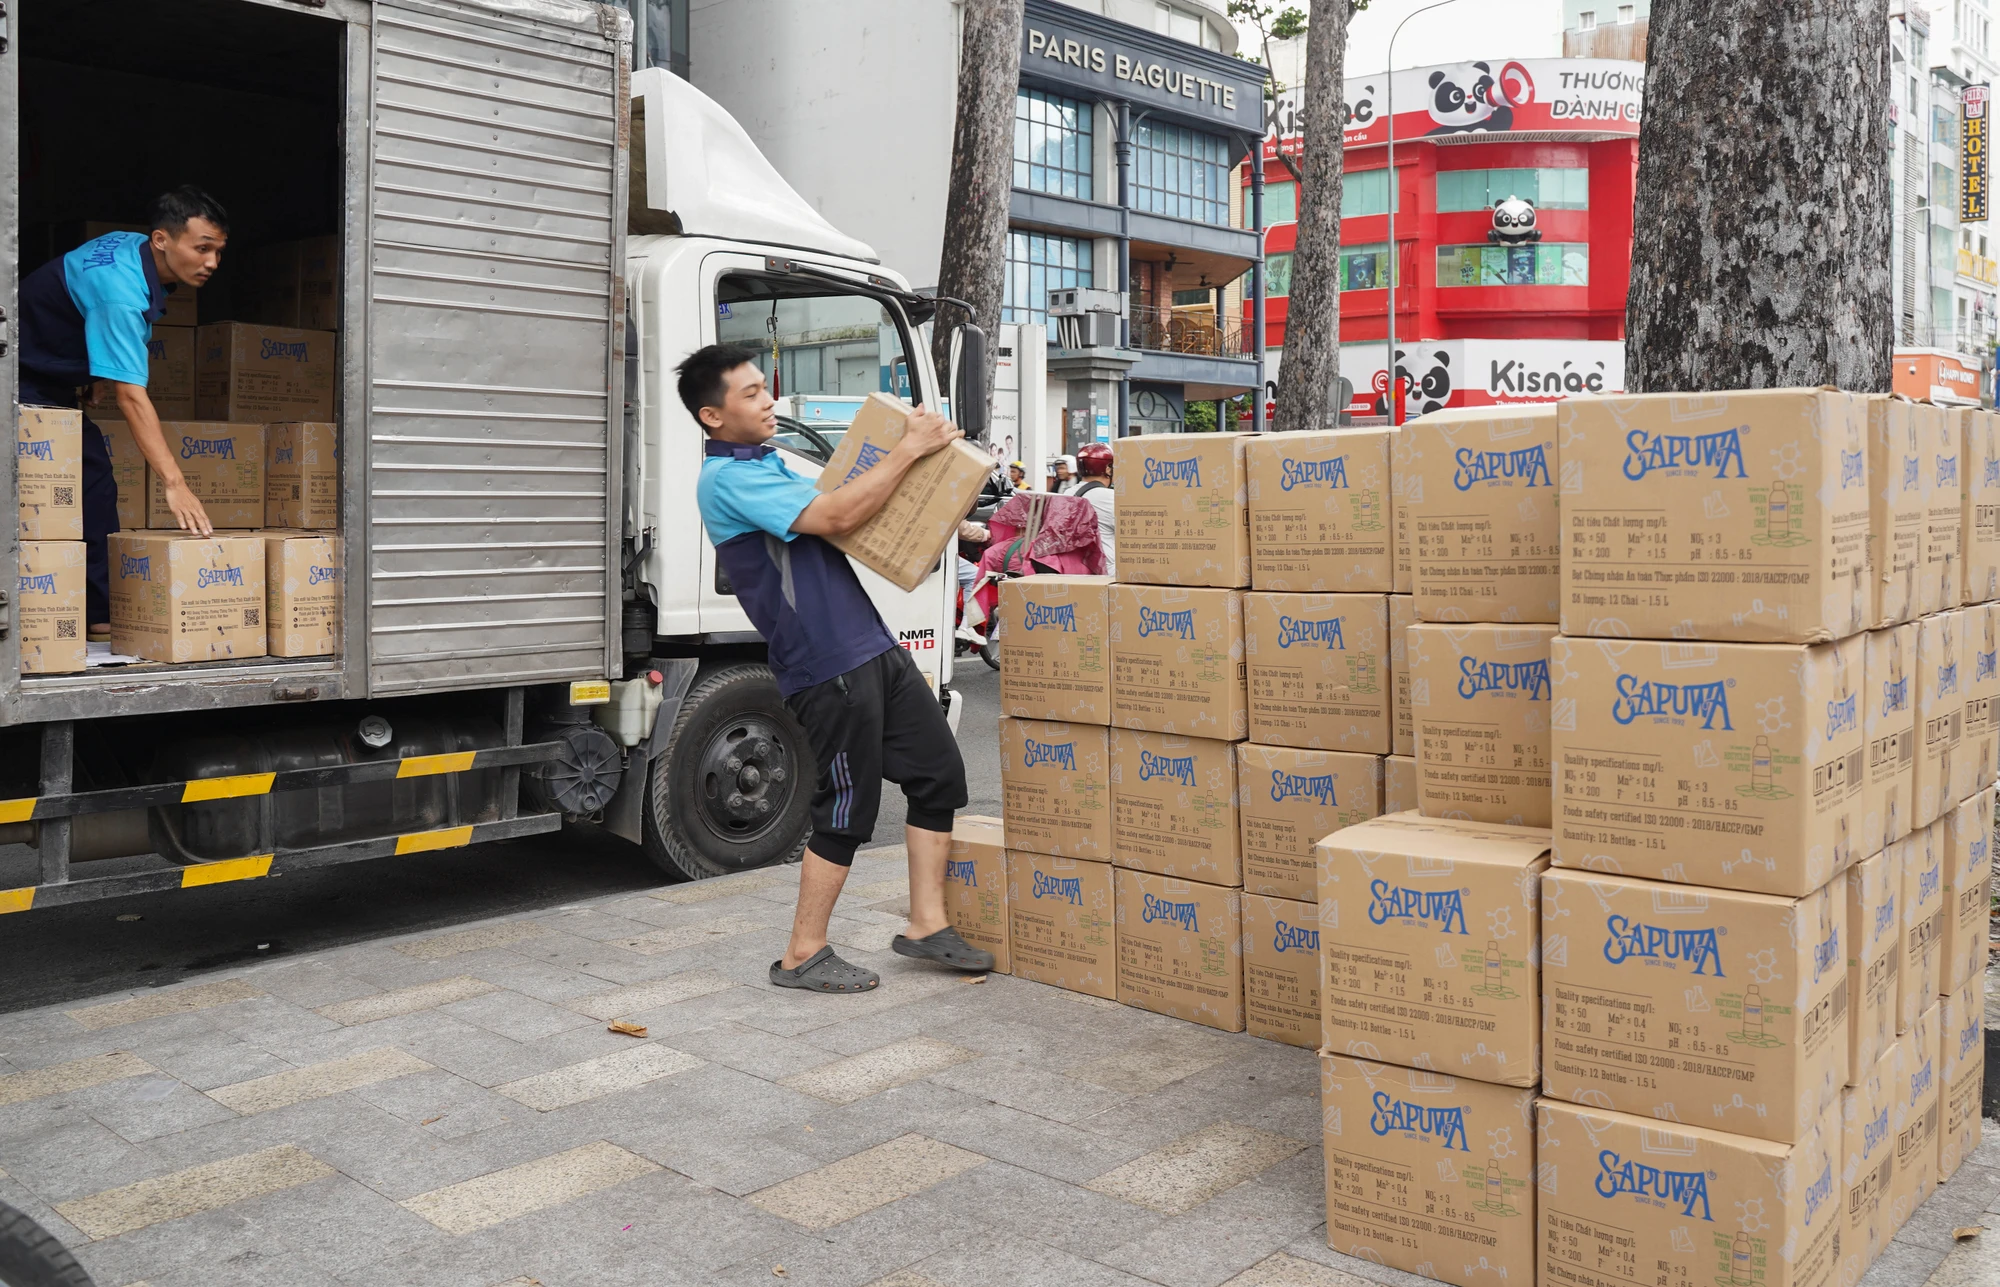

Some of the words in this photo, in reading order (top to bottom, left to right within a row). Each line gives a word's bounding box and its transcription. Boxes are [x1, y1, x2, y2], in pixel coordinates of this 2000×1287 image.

[1029, 29, 1106, 73] PARIS
[1116, 54, 1236, 110] BAGUETTE
[1553, 95, 1617, 117] DÀNH
[1967, 118, 1981, 213] HOTEL
[261, 338, 308, 362] SAPUWA
[1491, 360, 1604, 392] Kisnac
[181, 436, 236, 460] SAPUWA
[1623, 428, 1749, 481] SAPUWA
[1143, 457, 1202, 488] SAPUWA
[1281, 456, 1349, 491] SAPUWA
[1454, 444, 1553, 491] SAPUWA
[120, 553, 151, 581] SAPUWA
[198, 566, 244, 588] SAPUWA
[1698, 572, 1708, 582] ISO
[1712, 572, 1734, 582] 22000
[1610, 594, 1618, 604] 12
[1649, 596, 1660, 606] 1.5
[1024, 602, 1077, 632] SAPUWA
[1138, 606, 1196, 640] SAPUWA
[1278, 616, 1346, 649] SAPUWA
[899, 629, 934, 640] NMR
[1458, 656, 1552, 701] SAPUWA
[1612, 674, 1736, 730] SAPUWA
[1024, 739, 1077, 770] SAPUWA
[1139, 750, 1197, 787] SAPUWA
[1271, 770, 1338, 806] SAPUWA
[1033, 870, 1083, 906] SAPUWA
[1143, 893, 1199, 933] SAPUWA
[1368, 879, 1470, 935] SAPUWA
[1603, 914, 1727, 977] SAPUWA
[1556, 988, 1578, 1002] Quality
[1582, 995, 1630, 1010] specifications
[1577, 1022, 1590, 1032] 200
[1634, 1032, 1644, 1042] 1.5
[1578, 1008, 1586, 1018] 50
[1634, 1017, 1646, 1028] 0.4
[1555, 1038, 1573, 1051] Foods
[1576, 1044, 1598, 1057] safety
[1601, 1049, 1632, 1062] certified
[1635, 1053, 1647, 1064] ISO
[1650, 1056, 1674, 1069] 22000
[1693, 1041, 1705, 1052] 6.5
[1716, 1044, 1728, 1056] 8.5
[1555, 1060, 1586, 1077] Quantity:
[1590, 1068, 1598, 1078] 12
[1602, 1070, 1626, 1084] Bottles
[1638, 1076, 1648, 1088] 1.5
[1370, 1091, 1471, 1152] SAPUWA
[1334, 1154, 1352, 1168] Quality
[1354, 1161, 1394, 1177] specifications
[1352, 1173, 1360, 1182] 50
[1397, 1184, 1407, 1194] 0.4
[1352, 1185, 1363, 1196] 200
[1398, 1196, 1406, 1206] 1.5
[1595, 1150, 1715, 1222] SAPUWA
[1334, 1199, 1349, 1211] Foods
[1352, 1206, 1370, 1218] safety
[1372, 1212, 1396, 1224] certified
[1400, 1216, 1409, 1226] ISO
[1412, 1219, 1432, 1232] 22000
[1446, 1208, 1456, 1218] 6.5
[1464, 1212, 1475, 1222] 8.5
[1335, 1219, 1360, 1235] Quantity:
[1363, 1228, 1370, 1236] 12
[1373, 1230, 1393, 1243] Bottles
[1402, 1238, 1411, 1248] 1.5
